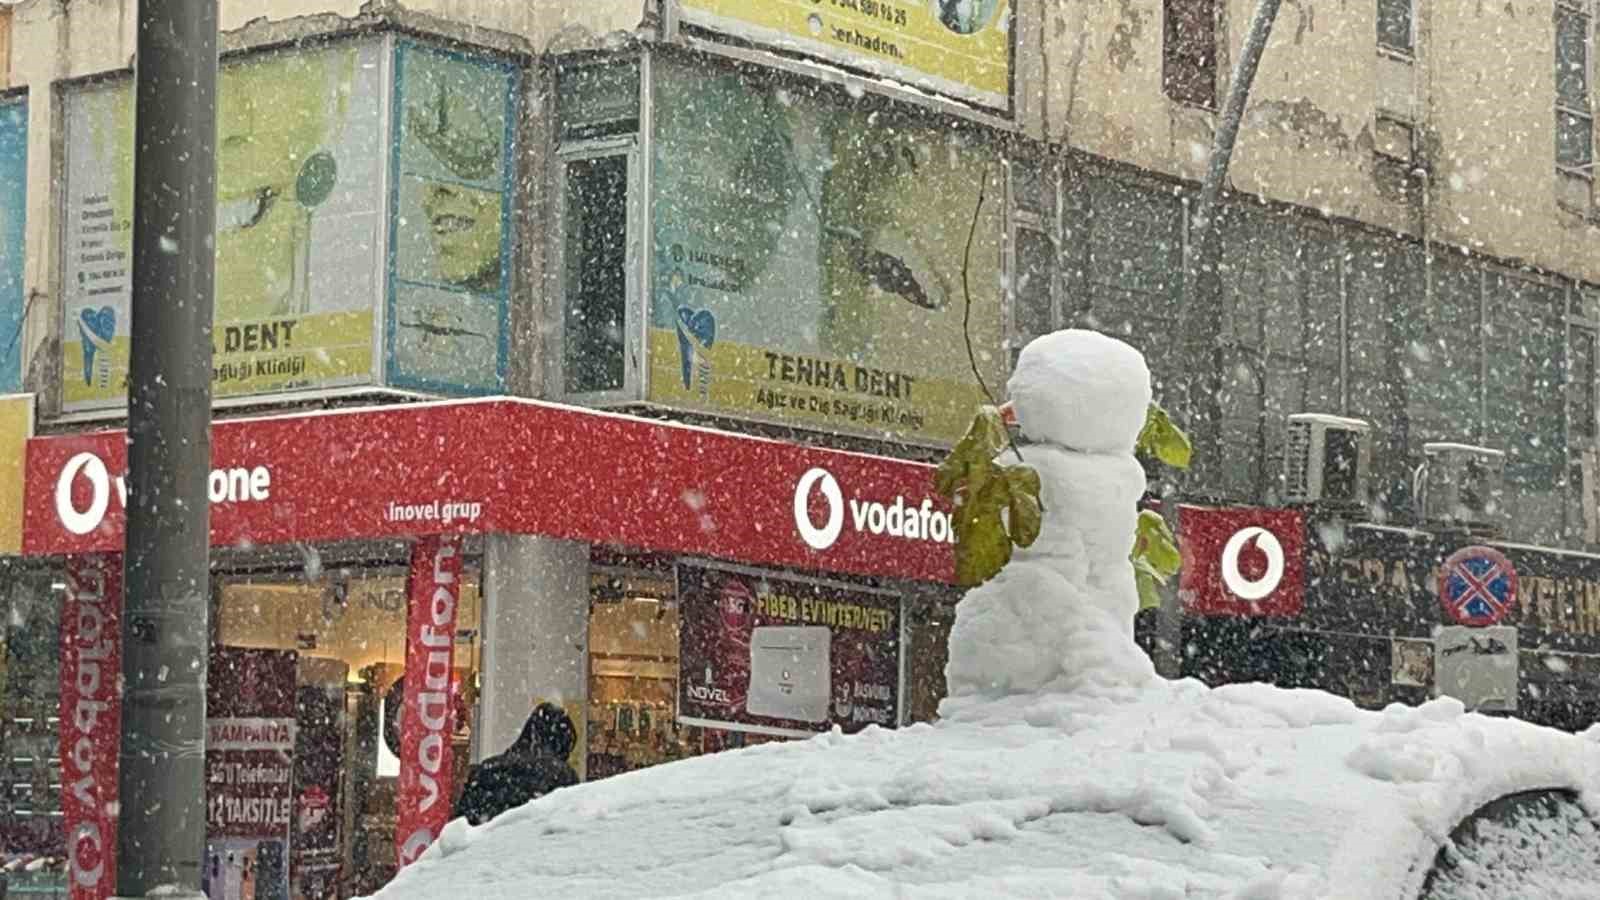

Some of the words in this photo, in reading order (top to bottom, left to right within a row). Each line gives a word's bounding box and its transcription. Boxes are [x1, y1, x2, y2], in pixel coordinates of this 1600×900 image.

[894, 7, 907, 27] 25
[225, 320, 297, 353] DENT
[855, 366, 914, 399] DENT
[441, 502, 481, 524] grup
